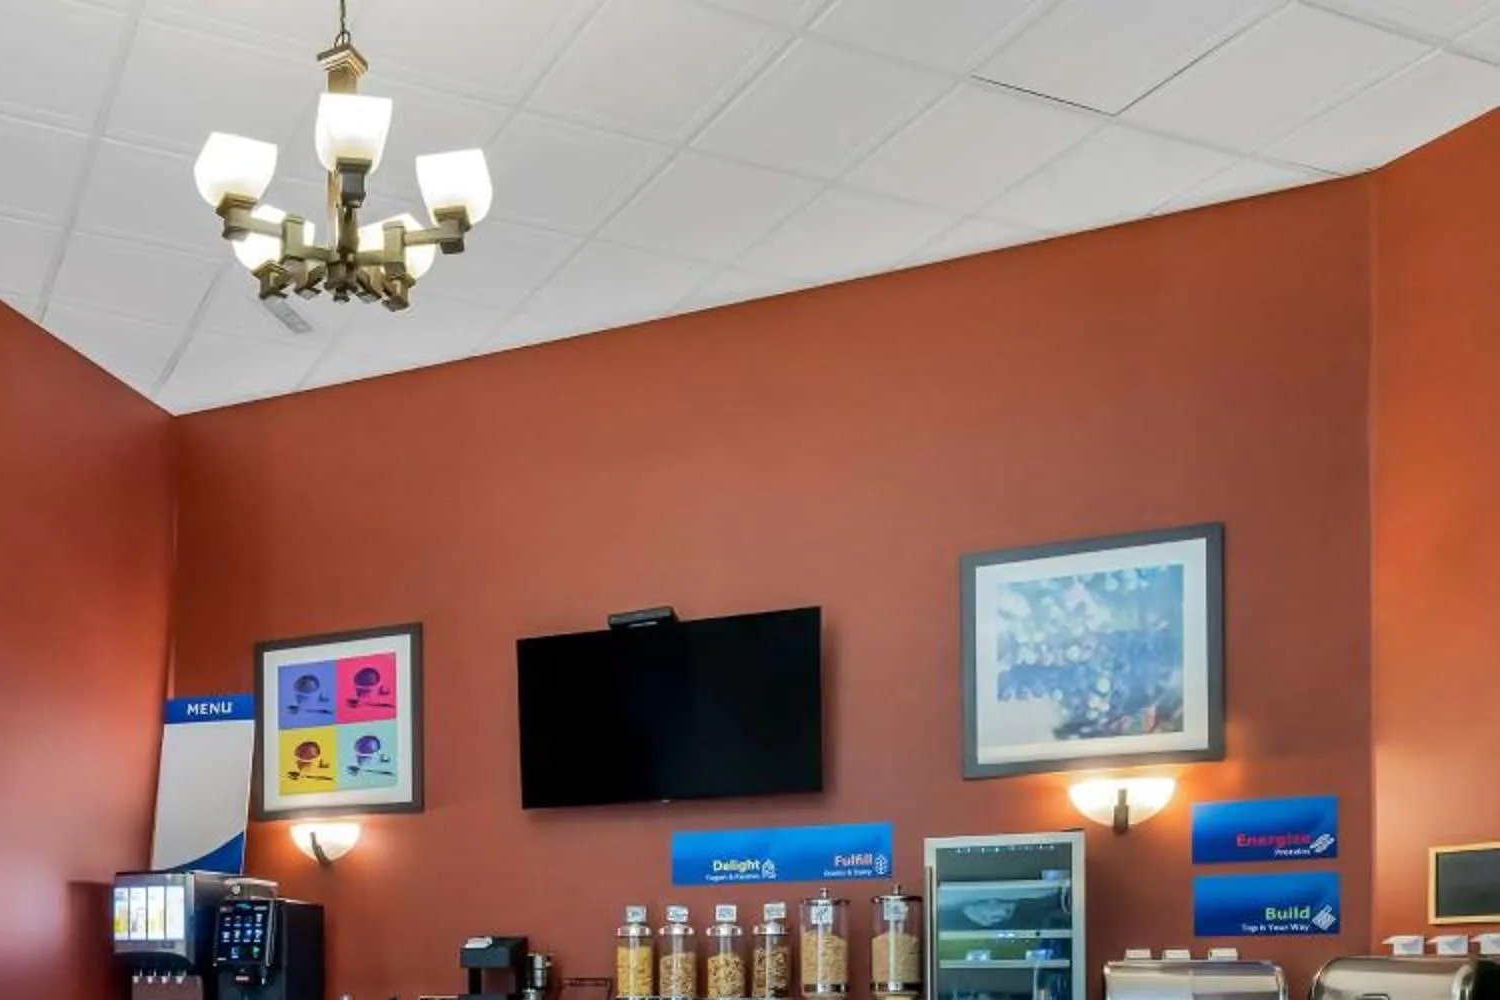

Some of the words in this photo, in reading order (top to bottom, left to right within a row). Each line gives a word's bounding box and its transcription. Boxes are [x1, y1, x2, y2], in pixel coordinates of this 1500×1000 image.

[187, 701, 233, 715] MENU
[713, 859, 760, 872] Delight
[835, 853, 873, 866] Fulfill
[1265, 906, 1311, 920] Build
[1289, 922, 1311, 932] Way
